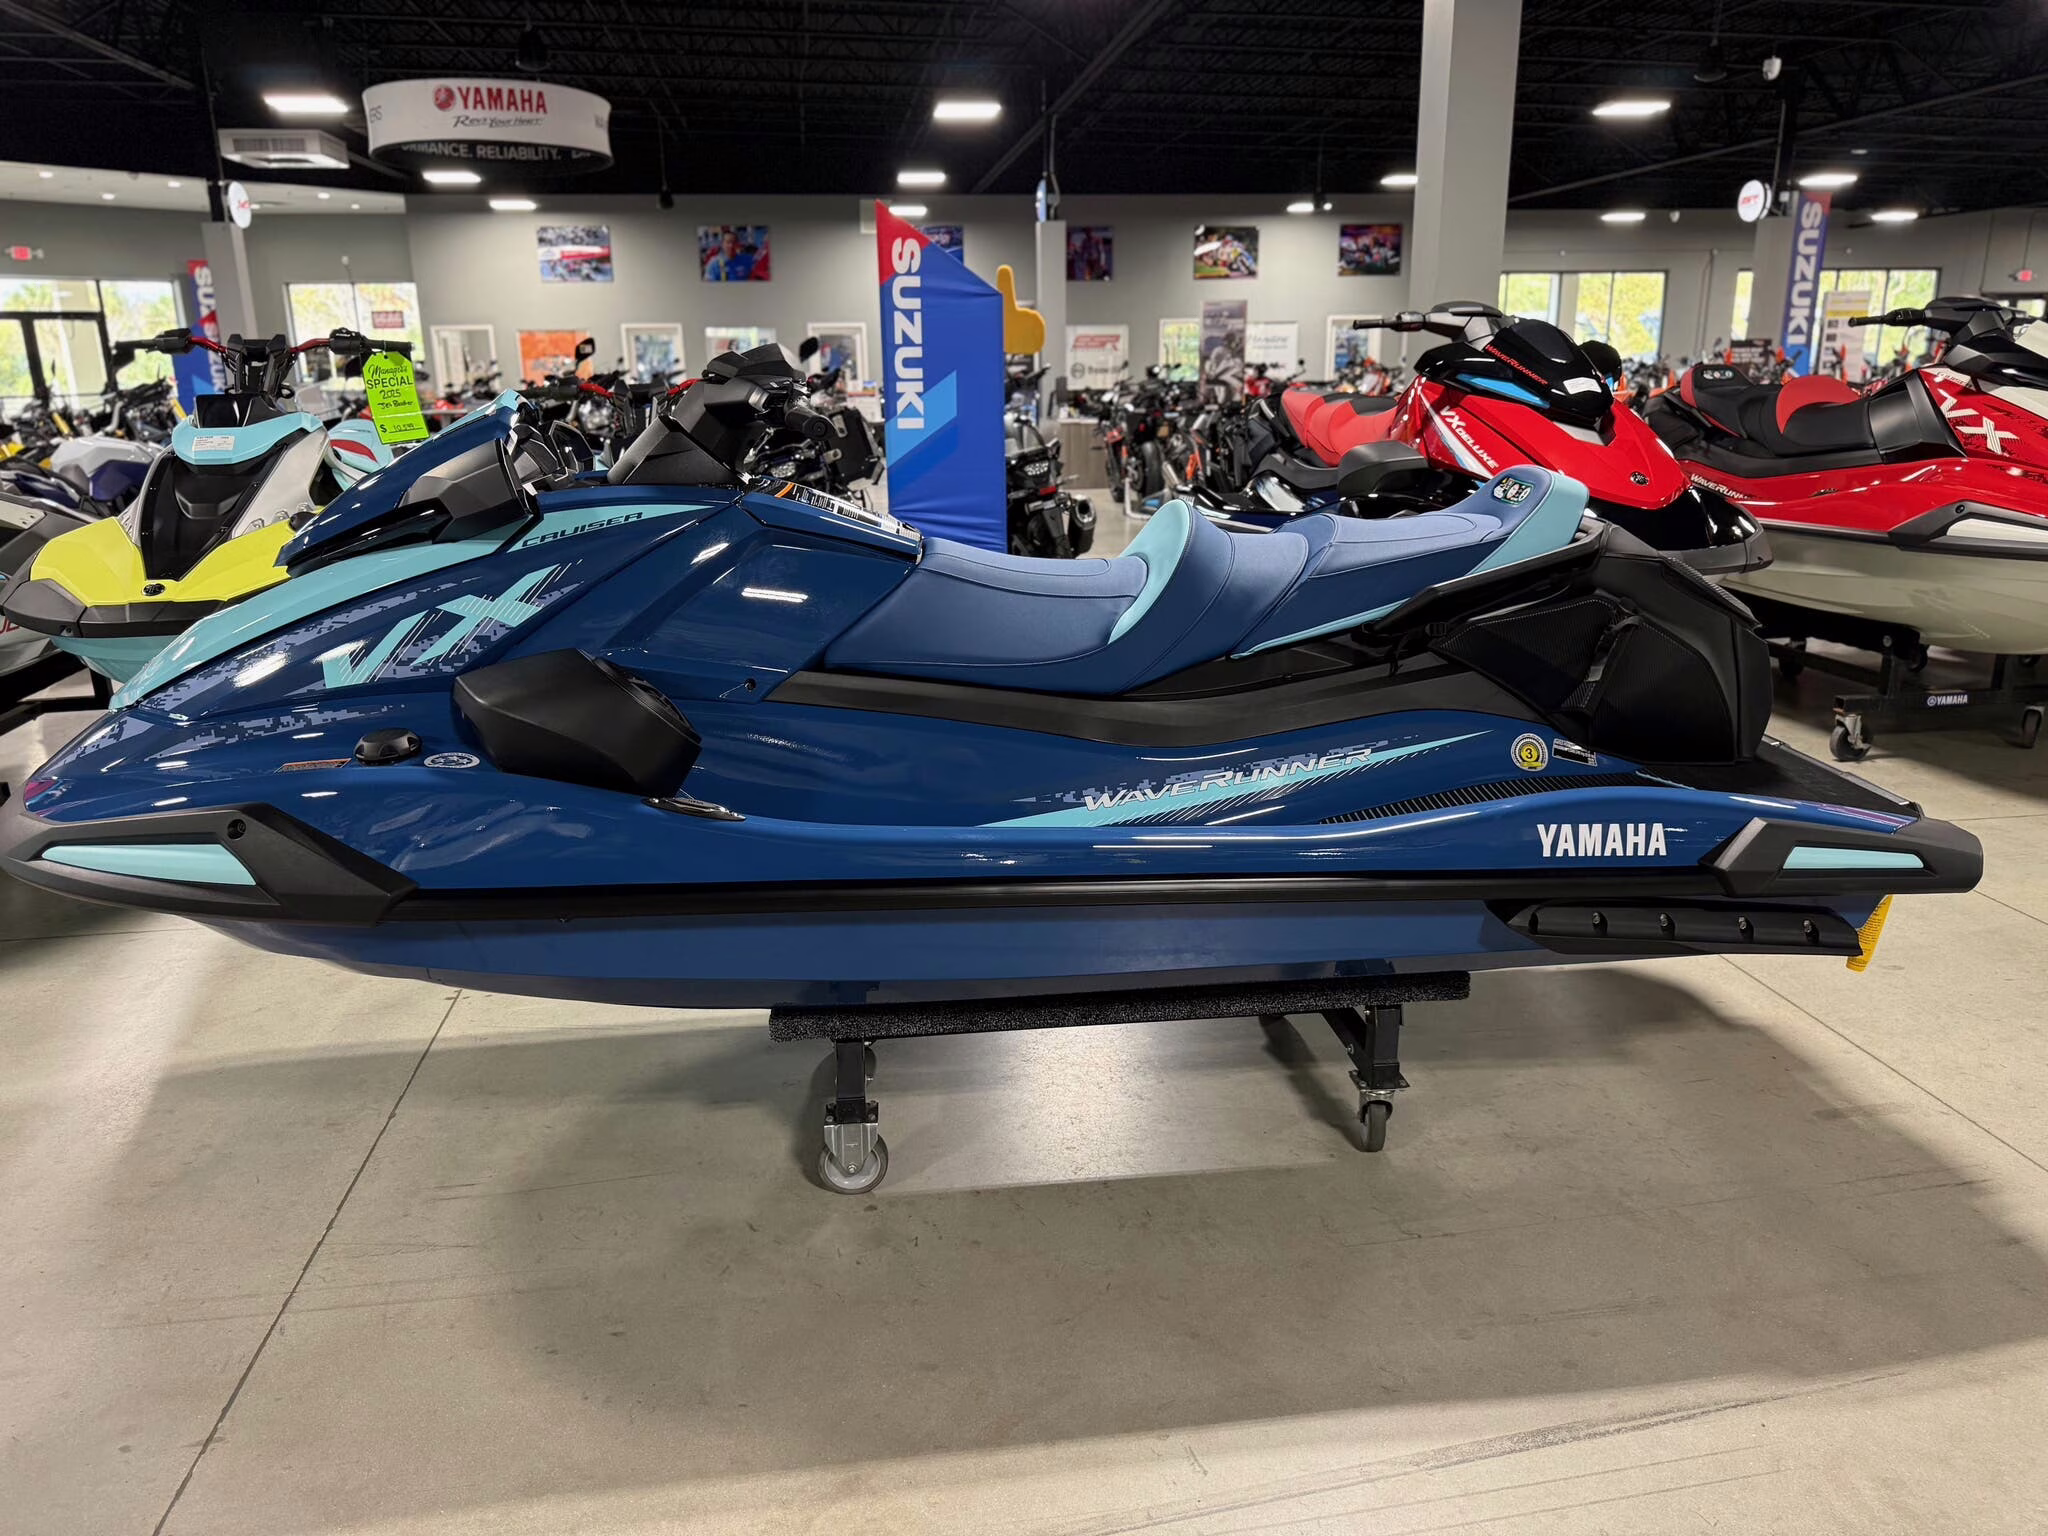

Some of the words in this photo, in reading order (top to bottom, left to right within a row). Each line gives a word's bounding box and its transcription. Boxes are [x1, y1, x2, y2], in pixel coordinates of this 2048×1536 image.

[457, 87, 548, 114] YAMAHA
[476, 144, 562, 161] RELIABILITY.
[1788, 201, 1823, 346] SUZUKI
[891, 237, 925, 430] SUZUKI
[366, 375, 413, 390] SPECIAL
[1485, 344, 1549, 386] WAVERUNNER
[379, 424, 388, 433] $
[1937, 388, 2021, 456] VX
[522, 512, 643, 548] CRUISER
[322, 563, 562, 689] VX
[1937, 694, 1968, 705] YAMAHA
[1525, 747, 1533, 759] 3
[1084, 748, 1372, 811] WAVERUNNER
[1537, 823, 1668, 857] YAMAHA
